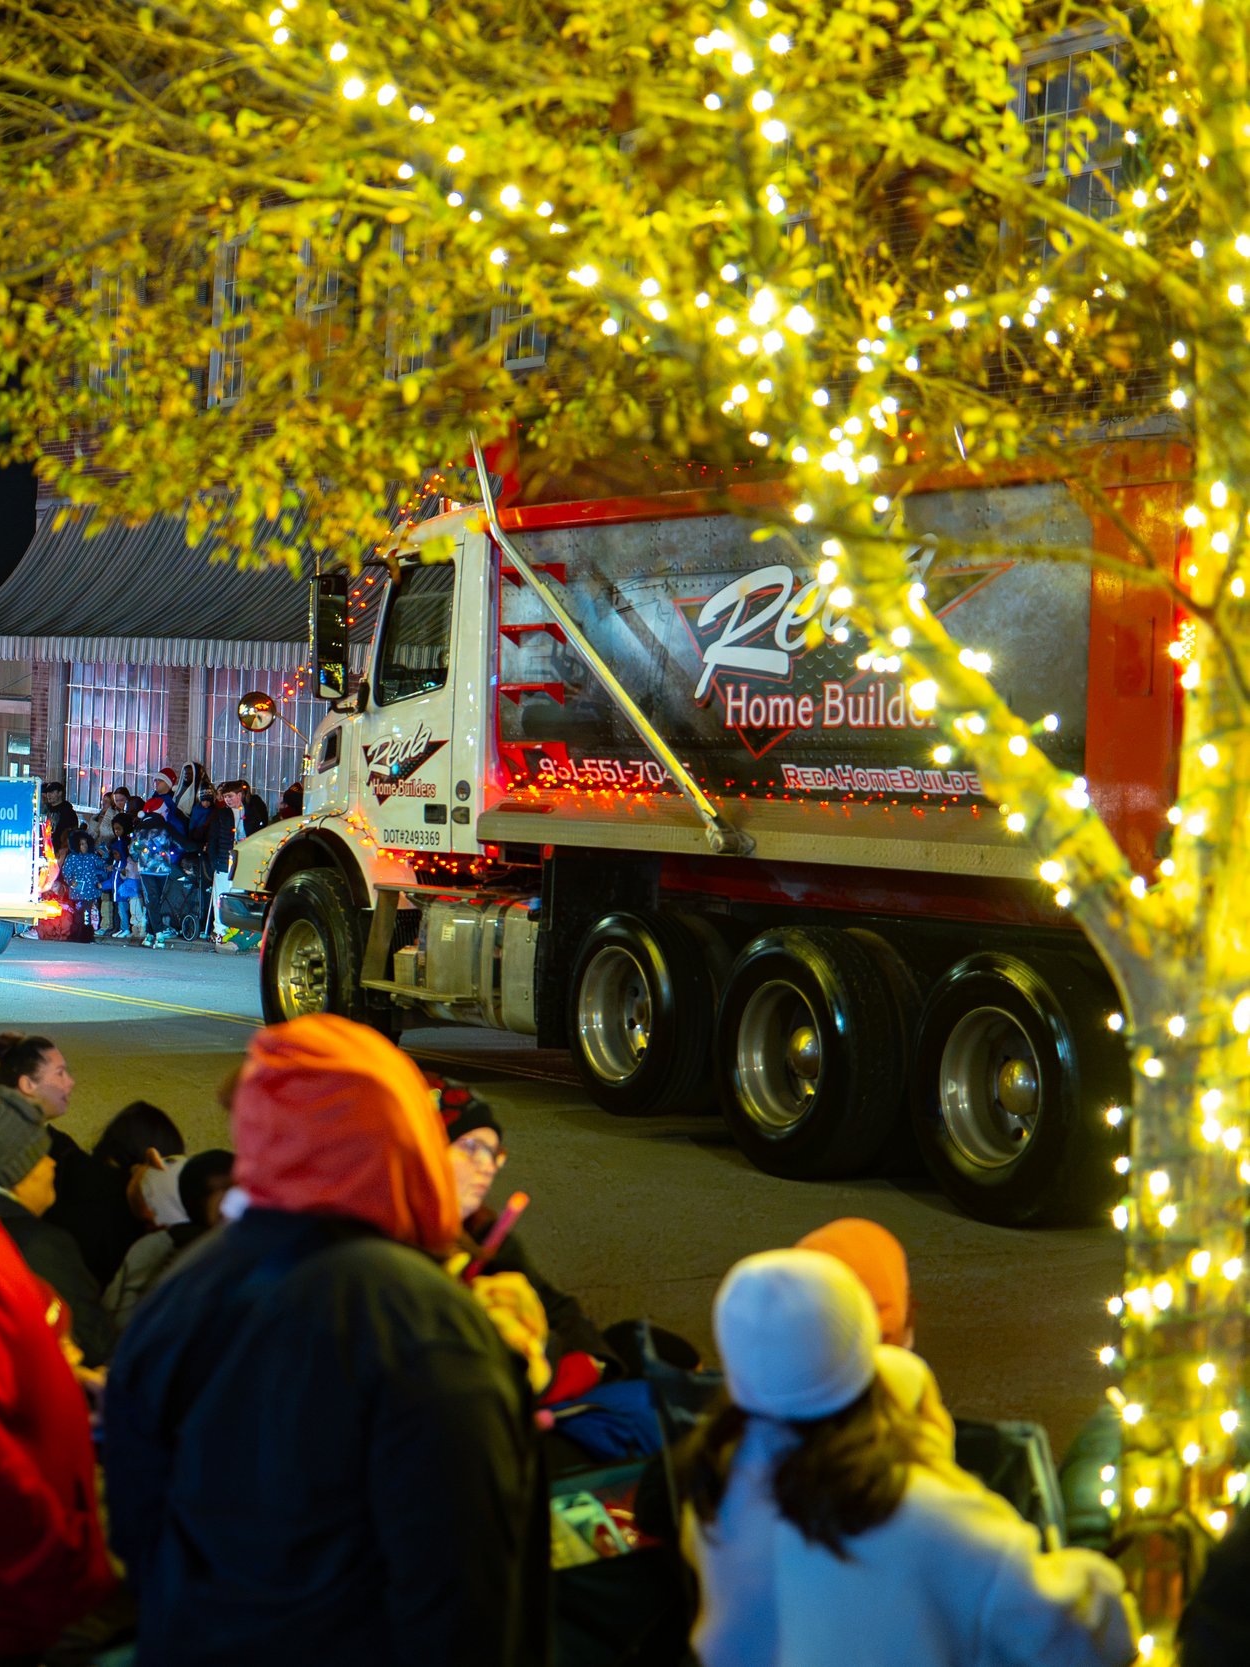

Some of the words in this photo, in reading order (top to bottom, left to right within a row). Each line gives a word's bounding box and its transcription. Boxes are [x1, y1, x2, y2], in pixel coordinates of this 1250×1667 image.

[725, 683, 813, 729] Home
[822, 682, 937, 729] Build
[366, 720, 432, 787] Reda
[539, 758, 694, 785] 931-551-70
[372, 778, 397, 796] Home
[397, 779, 437, 798] Builders
[383, 828, 440, 846] DOT#2493369
